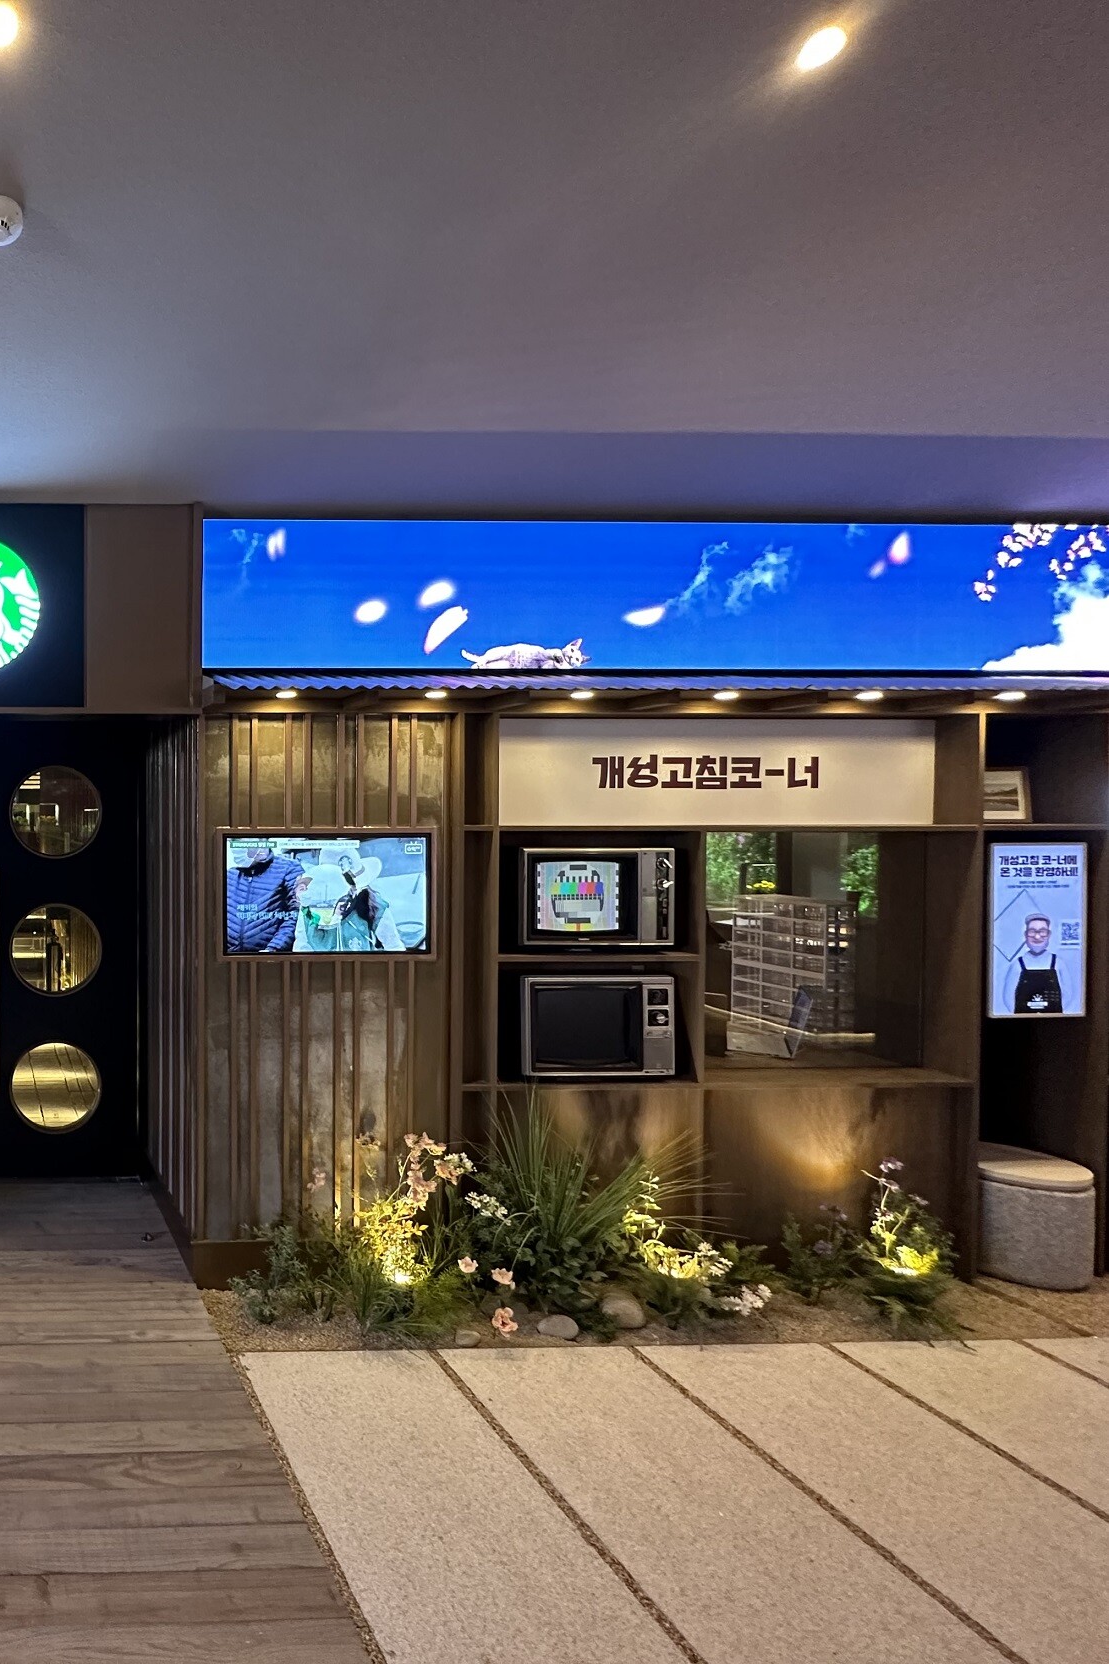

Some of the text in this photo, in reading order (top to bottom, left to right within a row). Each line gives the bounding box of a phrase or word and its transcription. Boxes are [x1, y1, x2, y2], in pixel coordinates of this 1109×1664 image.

[591, 754, 820, 790] 개성고침코-너
[999, 855, 1040, 866] 개성고침
[1000, 867, 1011, 877] 온
[1012, 867, 1033, 877] 것을
